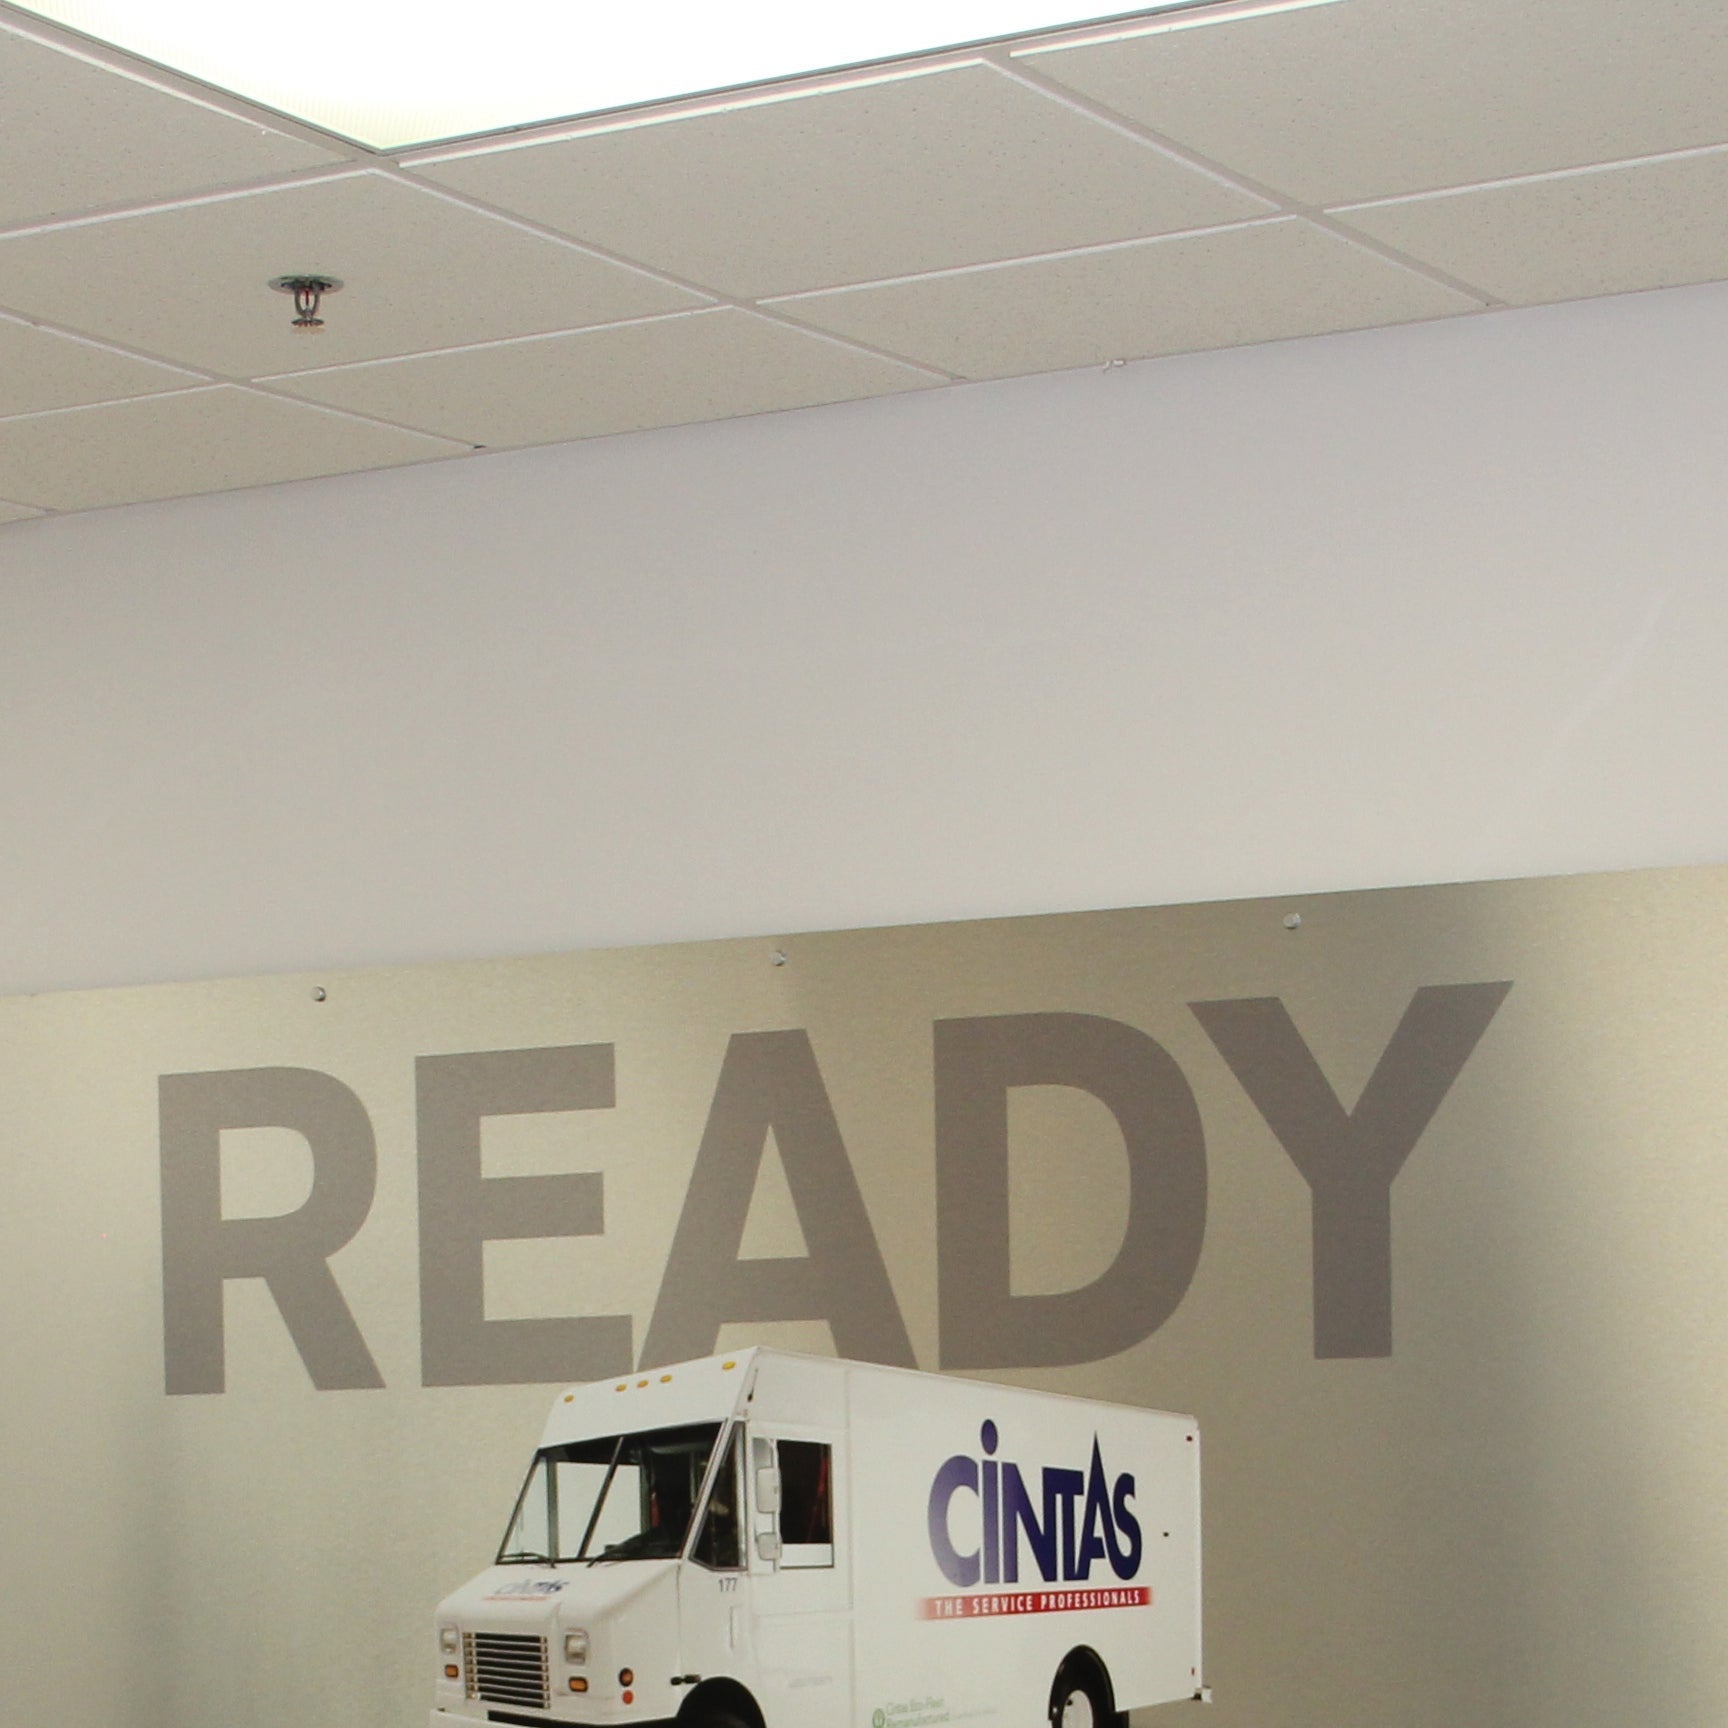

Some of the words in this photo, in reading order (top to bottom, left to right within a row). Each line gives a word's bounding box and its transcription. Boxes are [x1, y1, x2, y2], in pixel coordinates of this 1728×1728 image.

[157, 980, 1513, 1396] READY
[718, 1577, 738, 1593] 177
[935, 1598, 963, 1615] THE
[972, 1594, 1033, 1613] SERVICE
[1040, 1588, 1141, 1609] PROFESSIONALS
